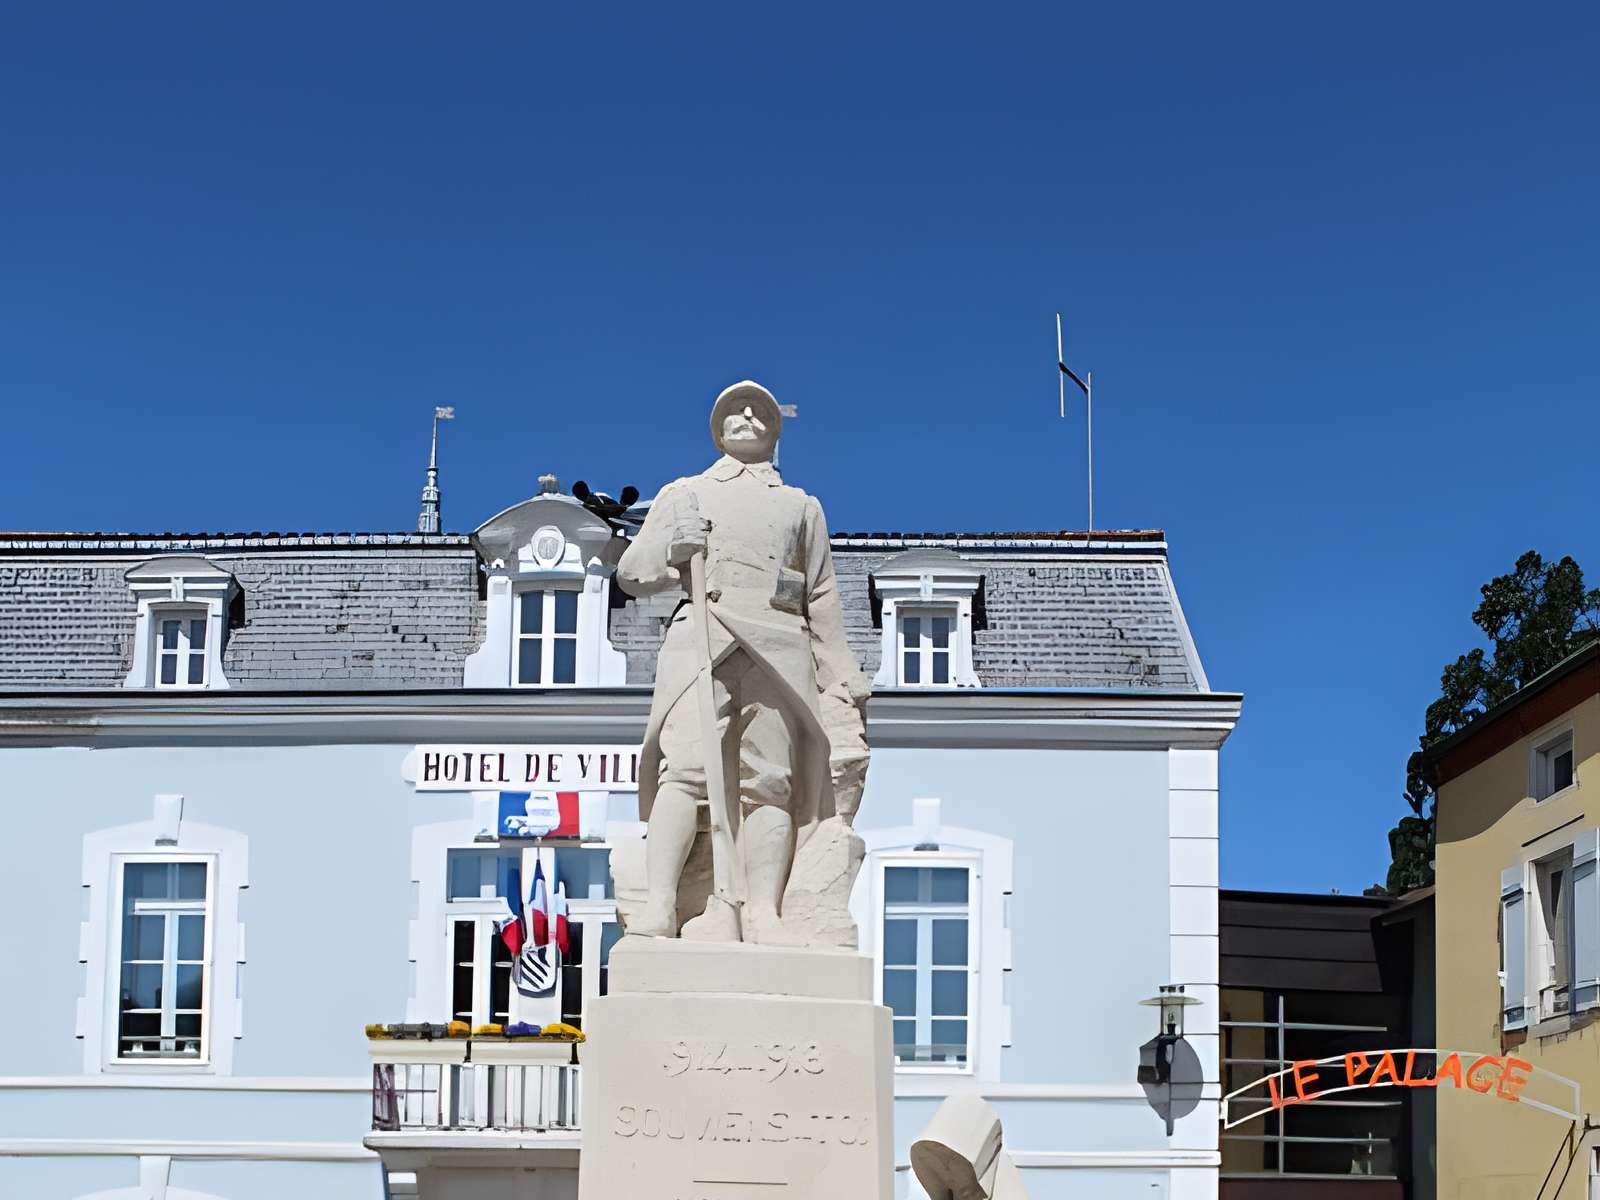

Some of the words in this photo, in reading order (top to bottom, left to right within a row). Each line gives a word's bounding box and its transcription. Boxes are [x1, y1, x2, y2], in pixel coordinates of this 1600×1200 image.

[525, 753, 563, 783] DE
[577, 753, 640, 783] VILL
[1267, 1059, 1324, 1109] LE
[1344, 1050, 1534, 1103] PALACE
